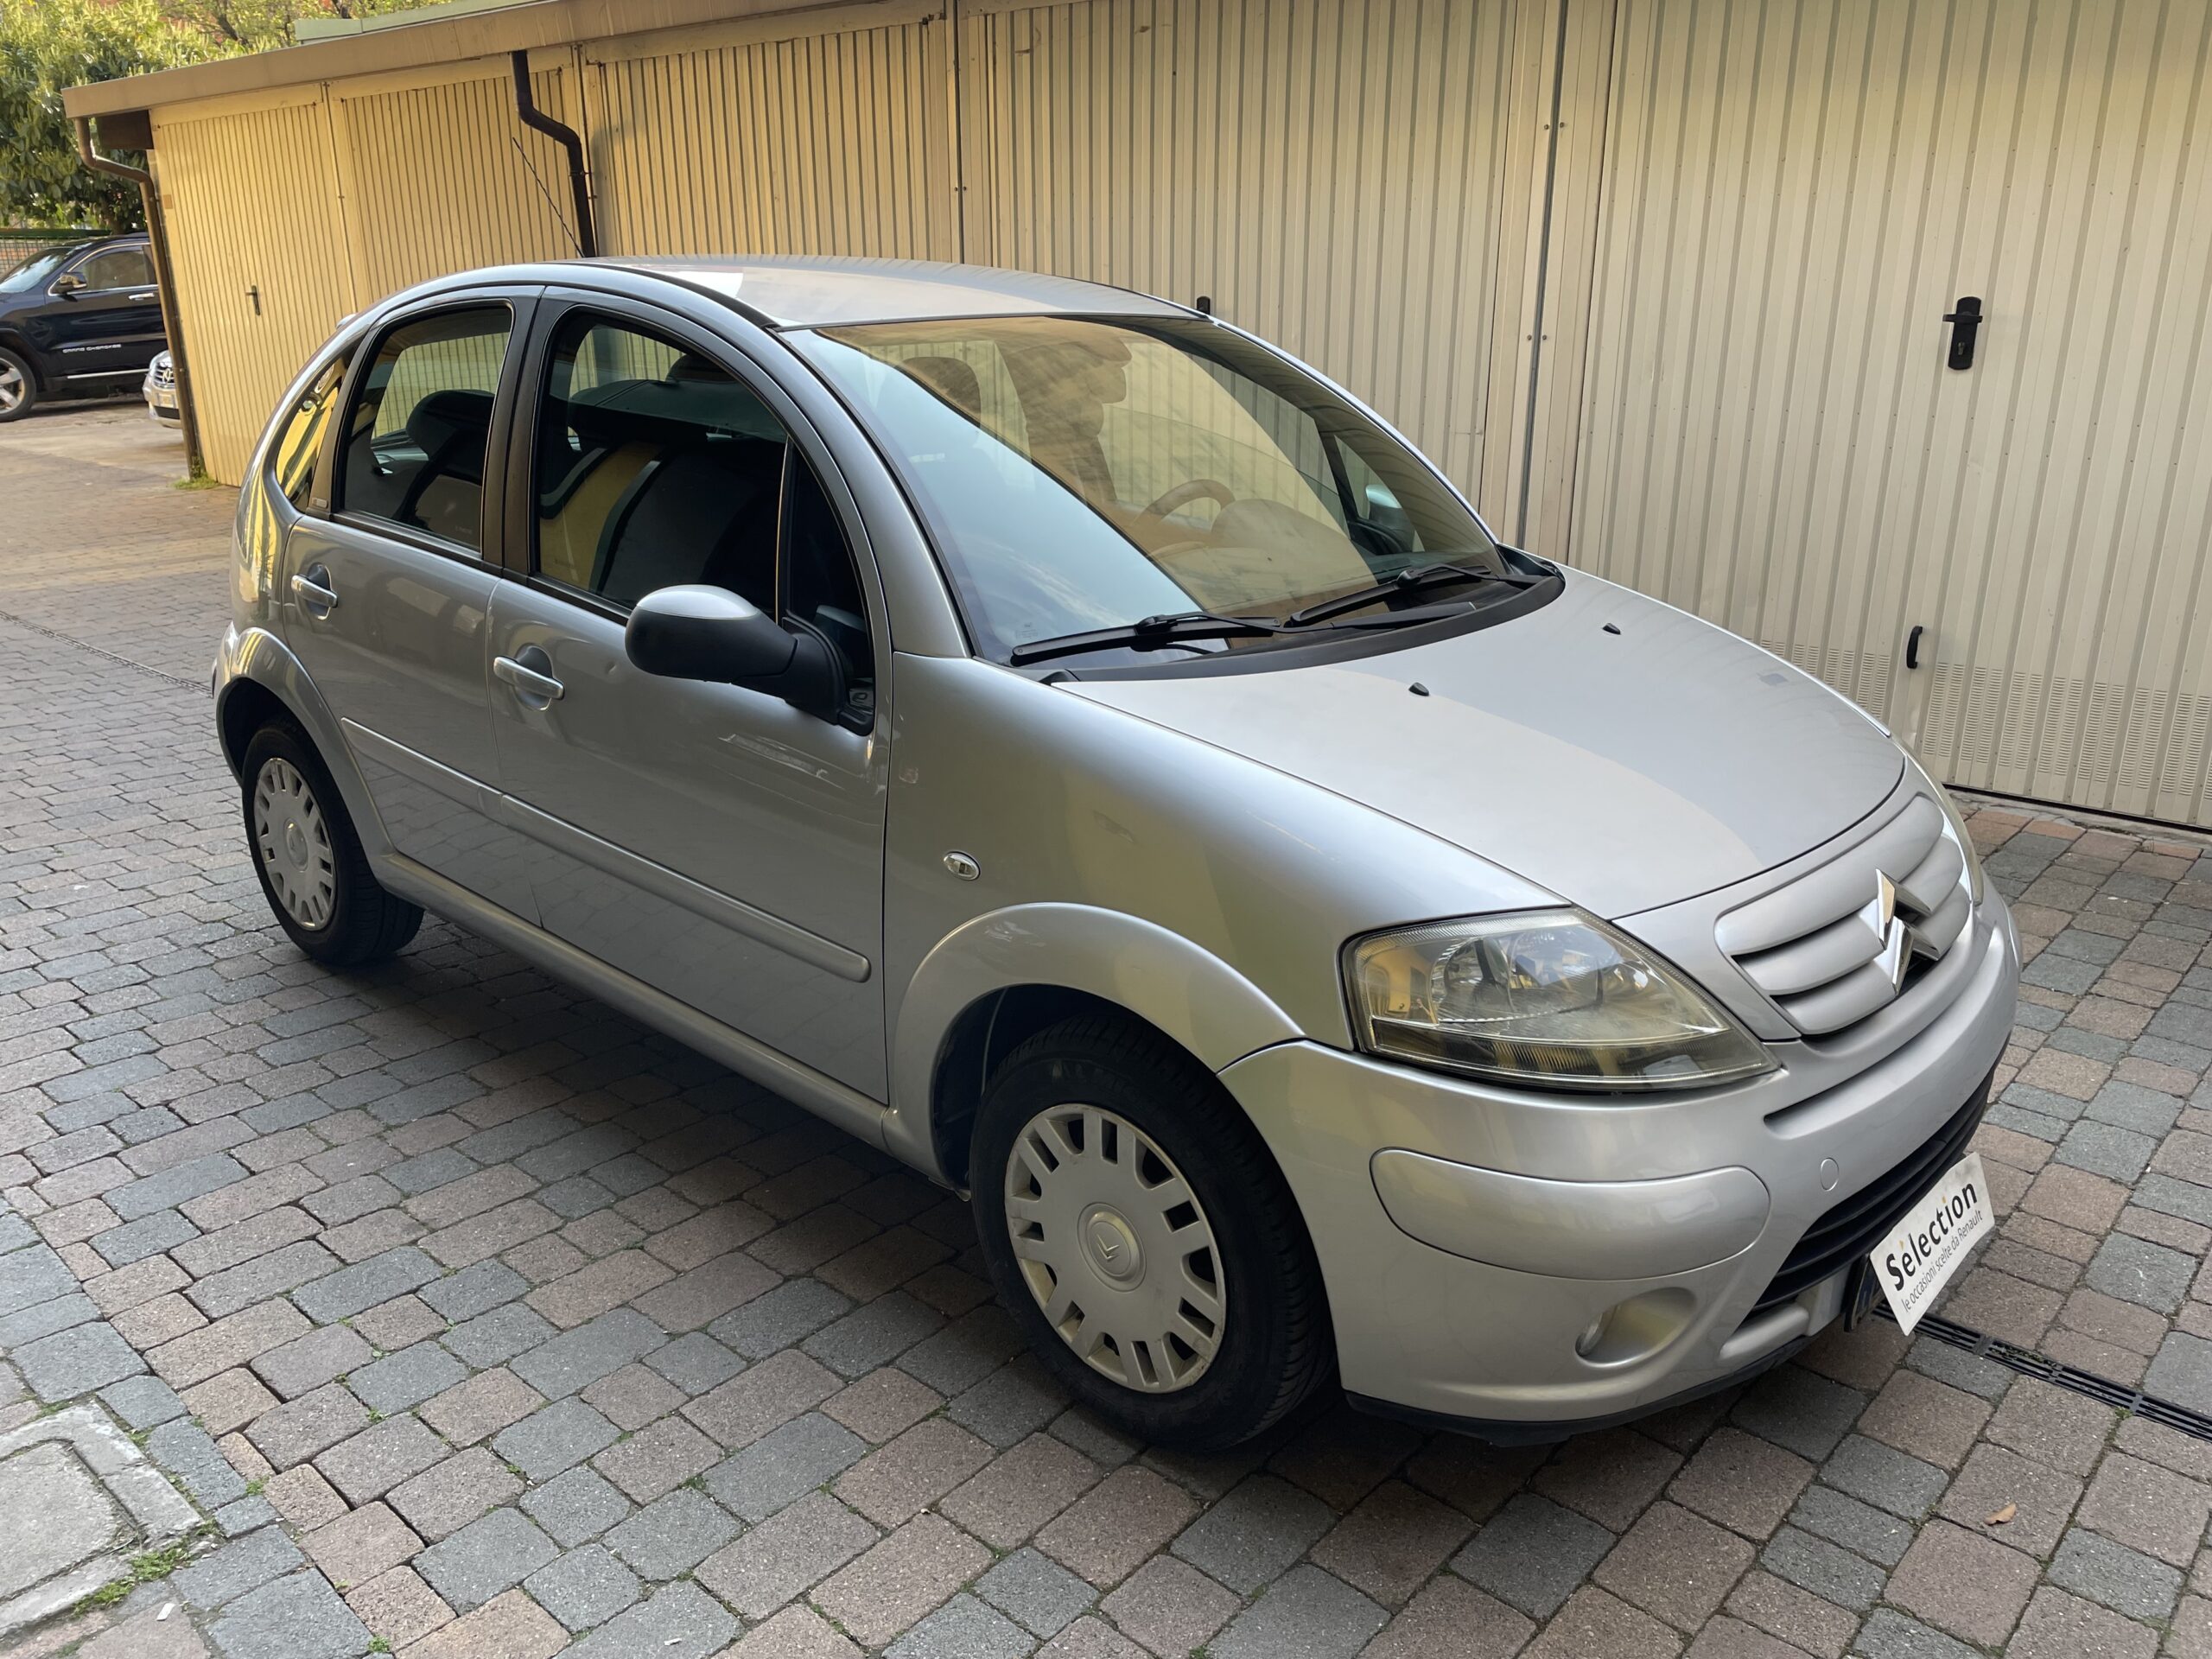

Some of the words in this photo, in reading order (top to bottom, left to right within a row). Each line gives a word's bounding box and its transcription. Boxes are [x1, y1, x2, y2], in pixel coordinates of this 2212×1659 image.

[1902, 1299, 1912, 1313] le
[1910, 1262, 1937, 1304] occasioni
[1935, 1245, 1953, 1272] scelte
[1950, 1236, 1961, 1251] da
[1957, 1210, 1983, 1242] Renault
